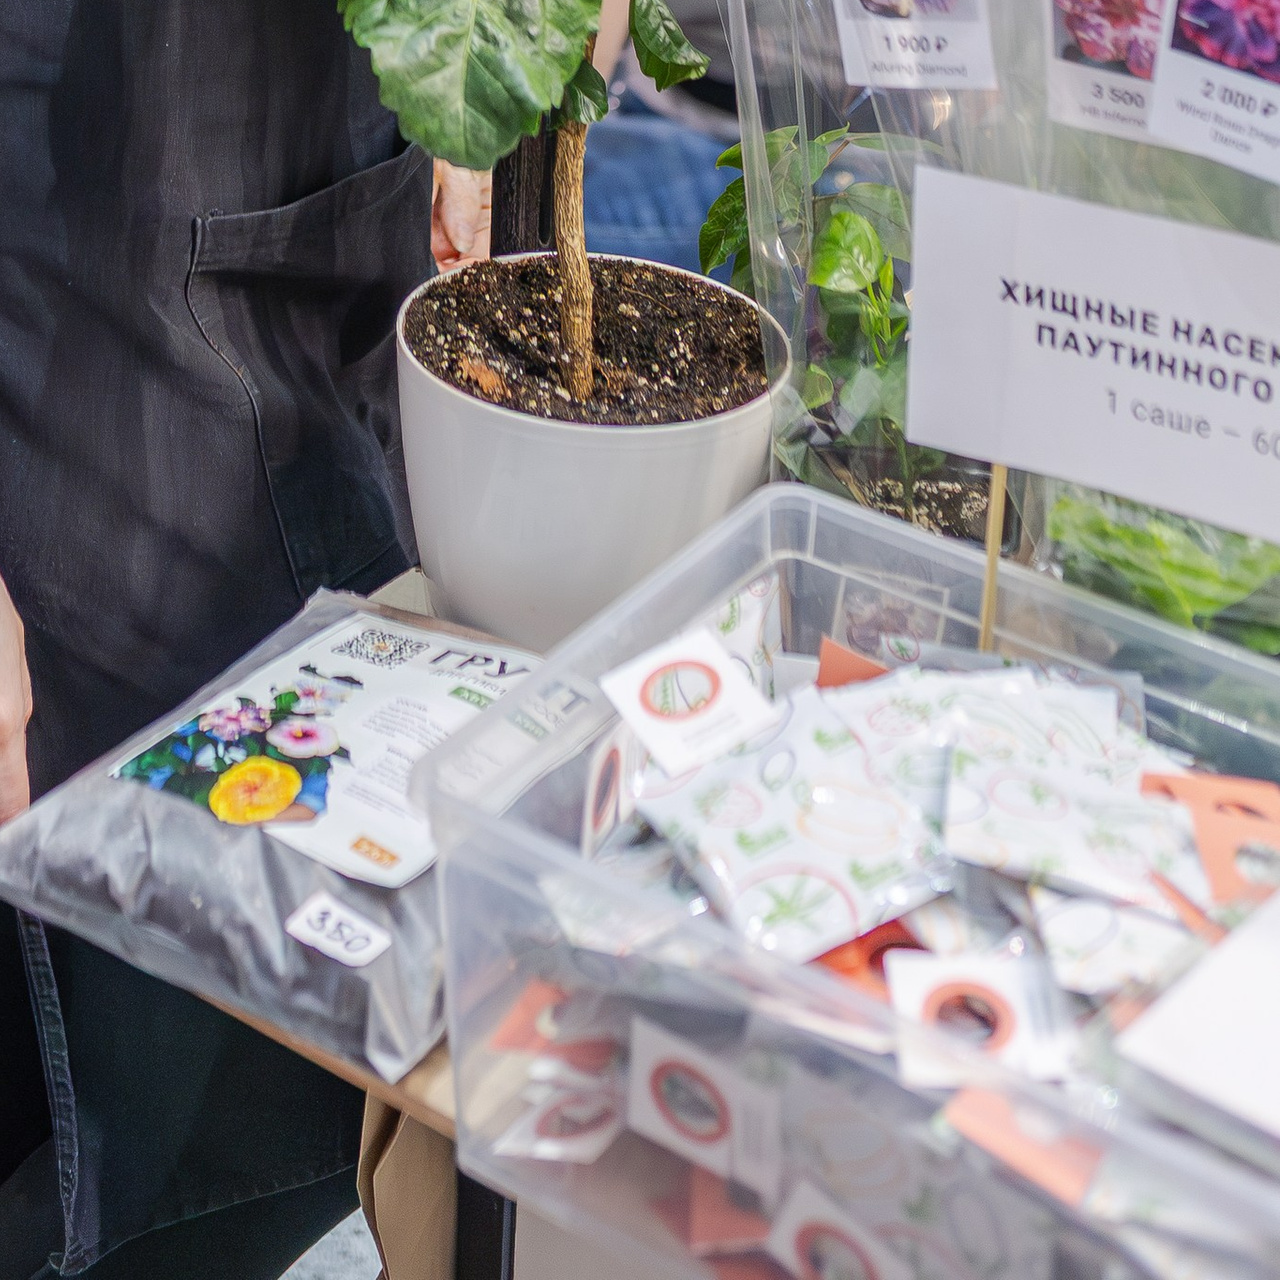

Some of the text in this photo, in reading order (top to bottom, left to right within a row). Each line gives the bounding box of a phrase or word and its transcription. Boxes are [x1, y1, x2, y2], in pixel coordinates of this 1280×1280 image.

[1000, 276, 1160, 337] ХИЩНЫЕ
[1036, 322, 1274, 403] ПАУТИННОГО
[1106, 388, 1117, 415] 1
[1130, 399, 1212, 439] саше
